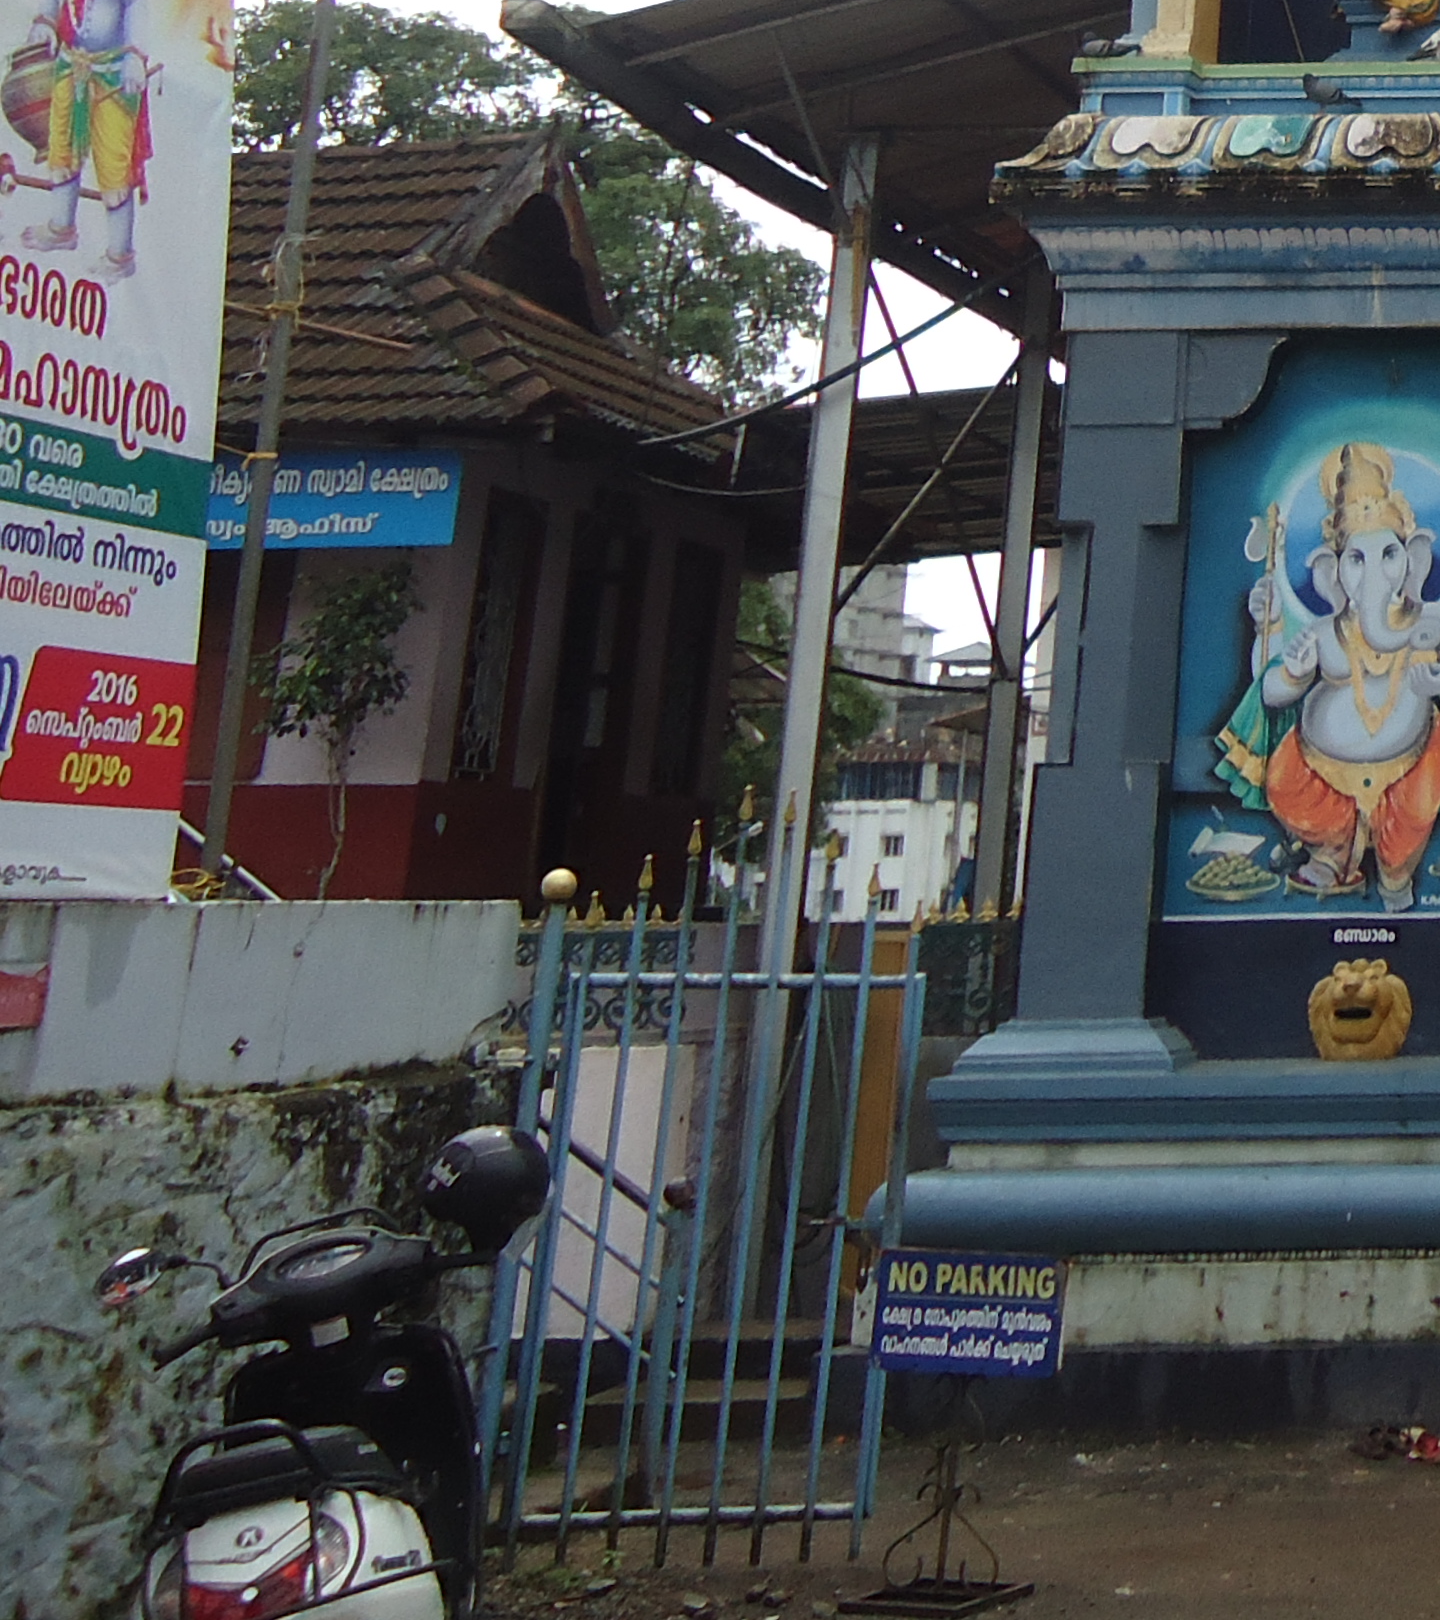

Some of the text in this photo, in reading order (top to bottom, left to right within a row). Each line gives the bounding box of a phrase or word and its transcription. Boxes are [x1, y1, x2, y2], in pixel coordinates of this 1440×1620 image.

[29, 434, 84, 469] വരെ
[26, 469, 159, 518] ക്ഷേത്രത്തിൽ
[308, 461, 366, 497] സ്വാമി
[370, 466, 449, 499] ക്ഷേത്രം
[93, 532, 177, 587] നിന്നും
[0, 565, 138, 618] ിയിലേയ്ക്ക്
[87, 670, 138, 705] 2016
[146, 703, 184, 747] 22
[60, 752, 132, 794] വ്യാഴം
[888, 1261, 1056, 1299] NO PARKING
